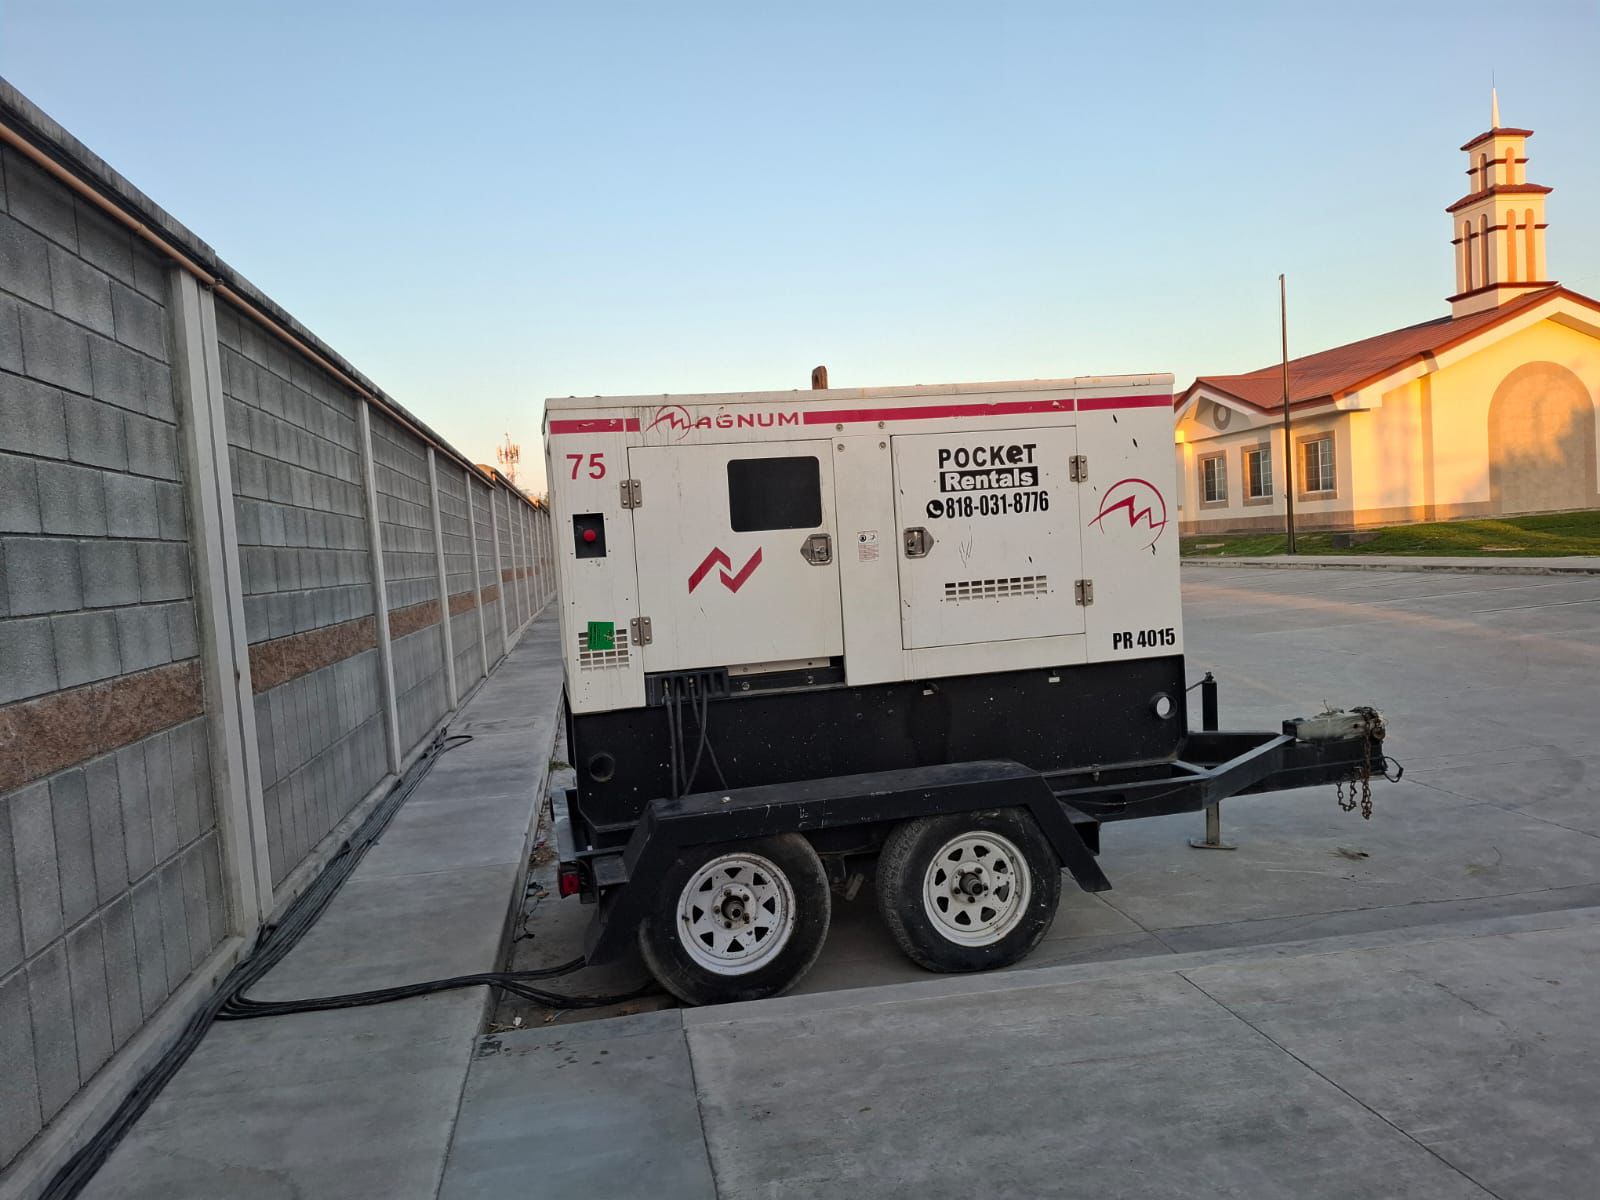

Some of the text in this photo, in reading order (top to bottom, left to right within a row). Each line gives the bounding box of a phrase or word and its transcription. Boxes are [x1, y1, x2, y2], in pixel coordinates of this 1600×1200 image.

[566, 452, 607, 480] 75
[944, 468, 1035, 491] Rentals
[945, 490, 1049, 519] 818-031-8776
[1112, 627, 1176, 650] PR 4015
